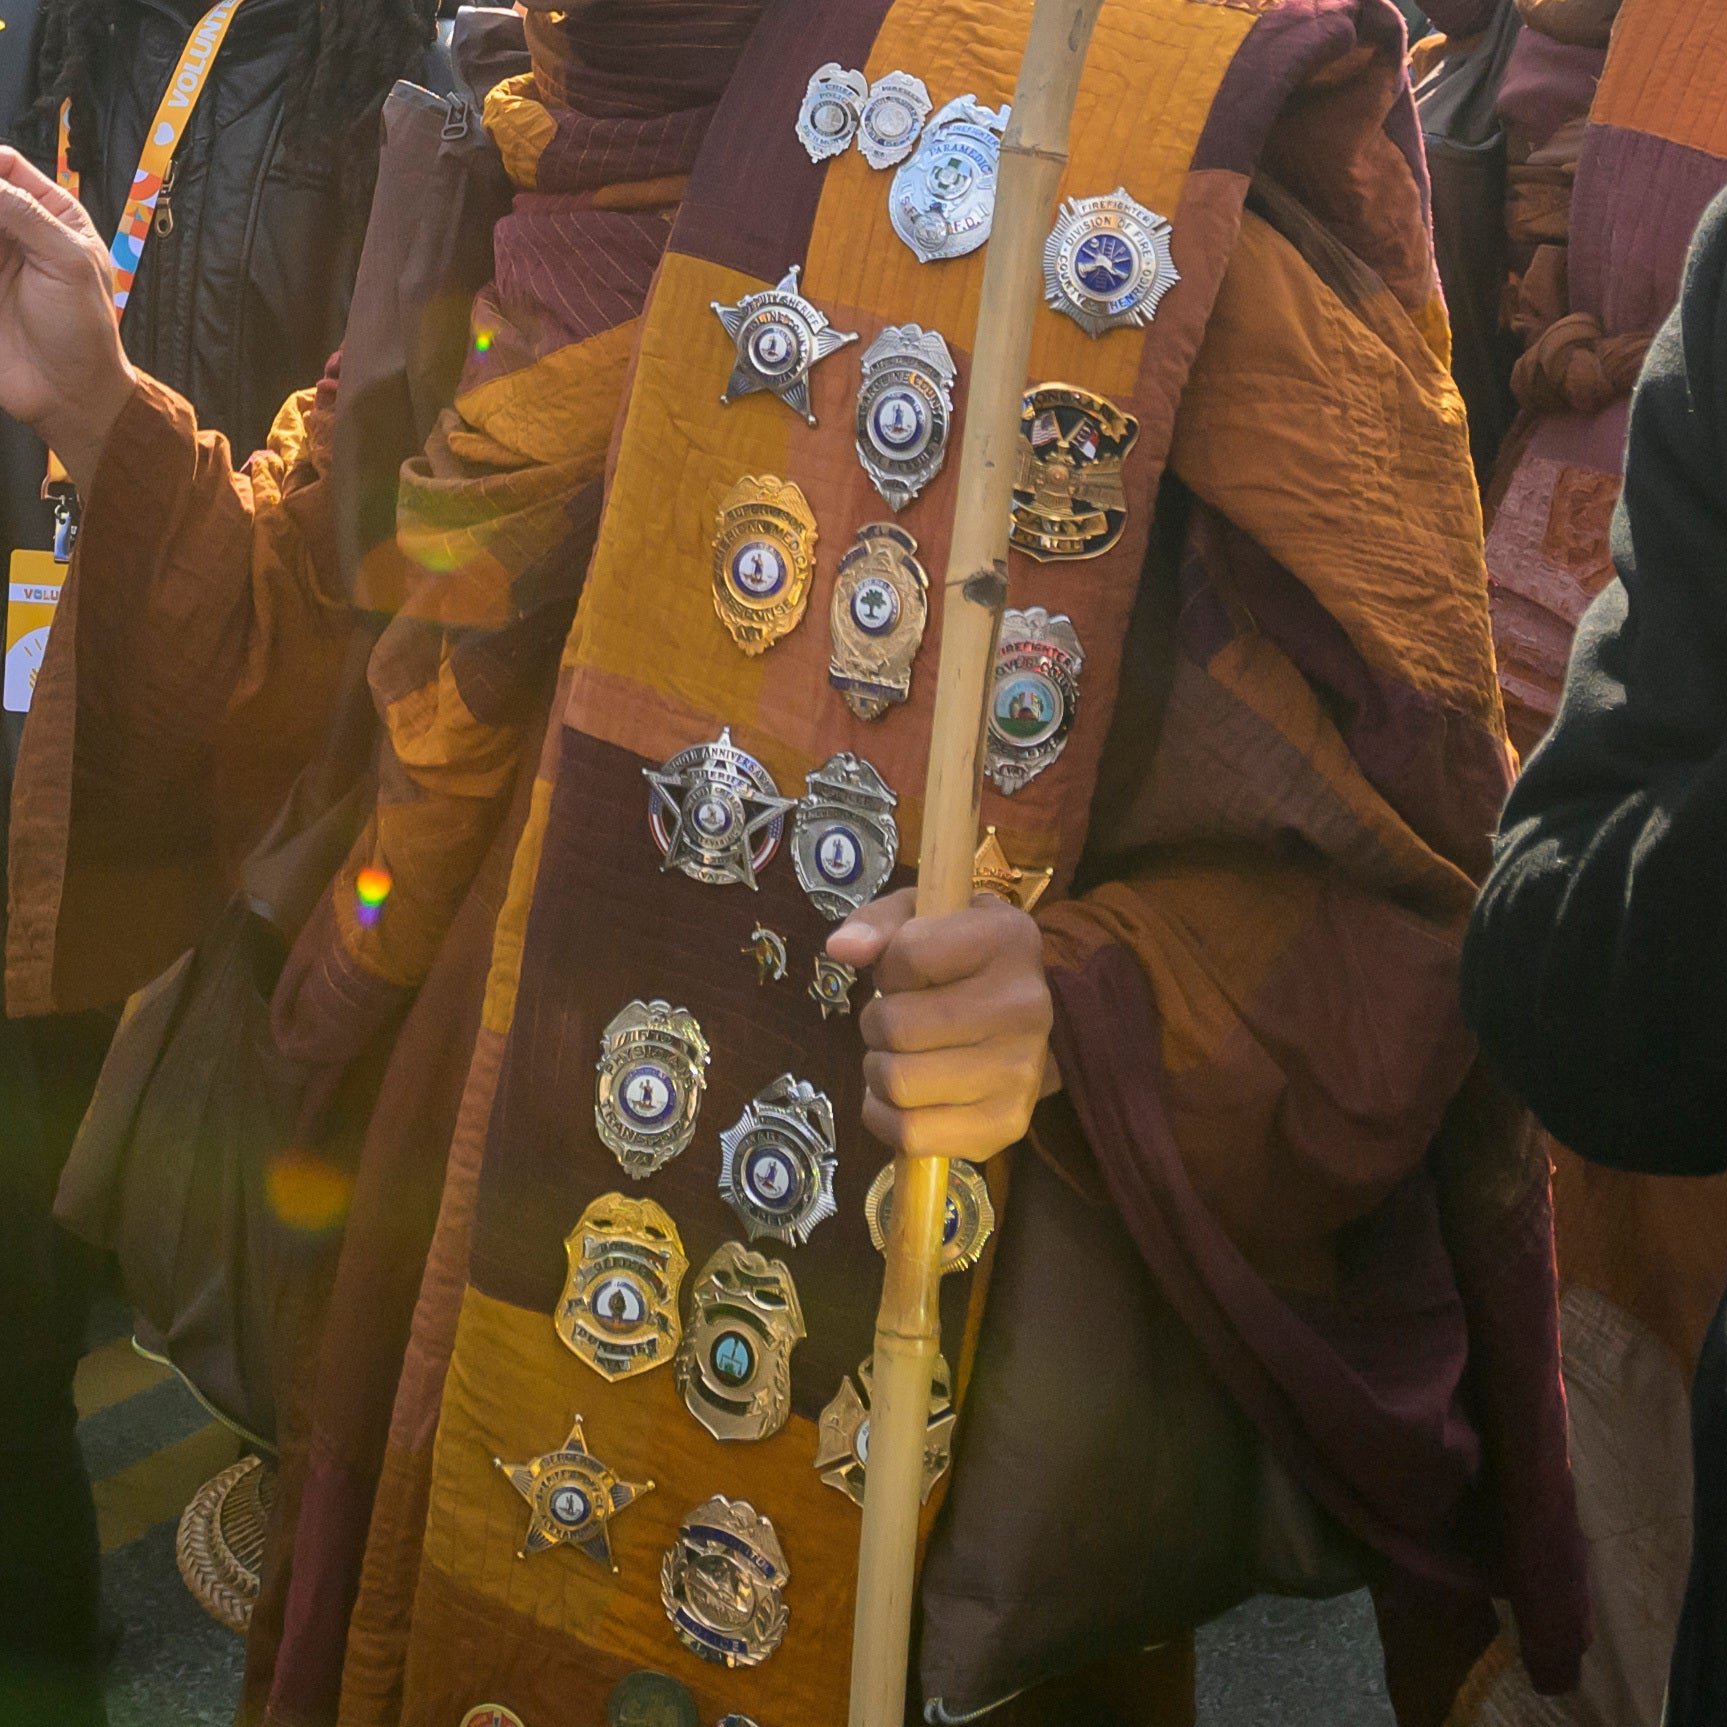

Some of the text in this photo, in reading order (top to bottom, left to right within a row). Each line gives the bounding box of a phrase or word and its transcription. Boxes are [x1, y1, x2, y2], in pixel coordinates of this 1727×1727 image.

[929, 143, 994, 174] PARAMEDIC
[1080, 199, 1152, 224] FIREFIGHTER
[1065, 215, 1153, 259] DIVISION OF FIRE
[1057, 254, 1153, 311] COUNTY HENRICO
[785, 298, 820, 327] SHERIFF
[1000, 640, 1072, 668] IREFIGHTER
